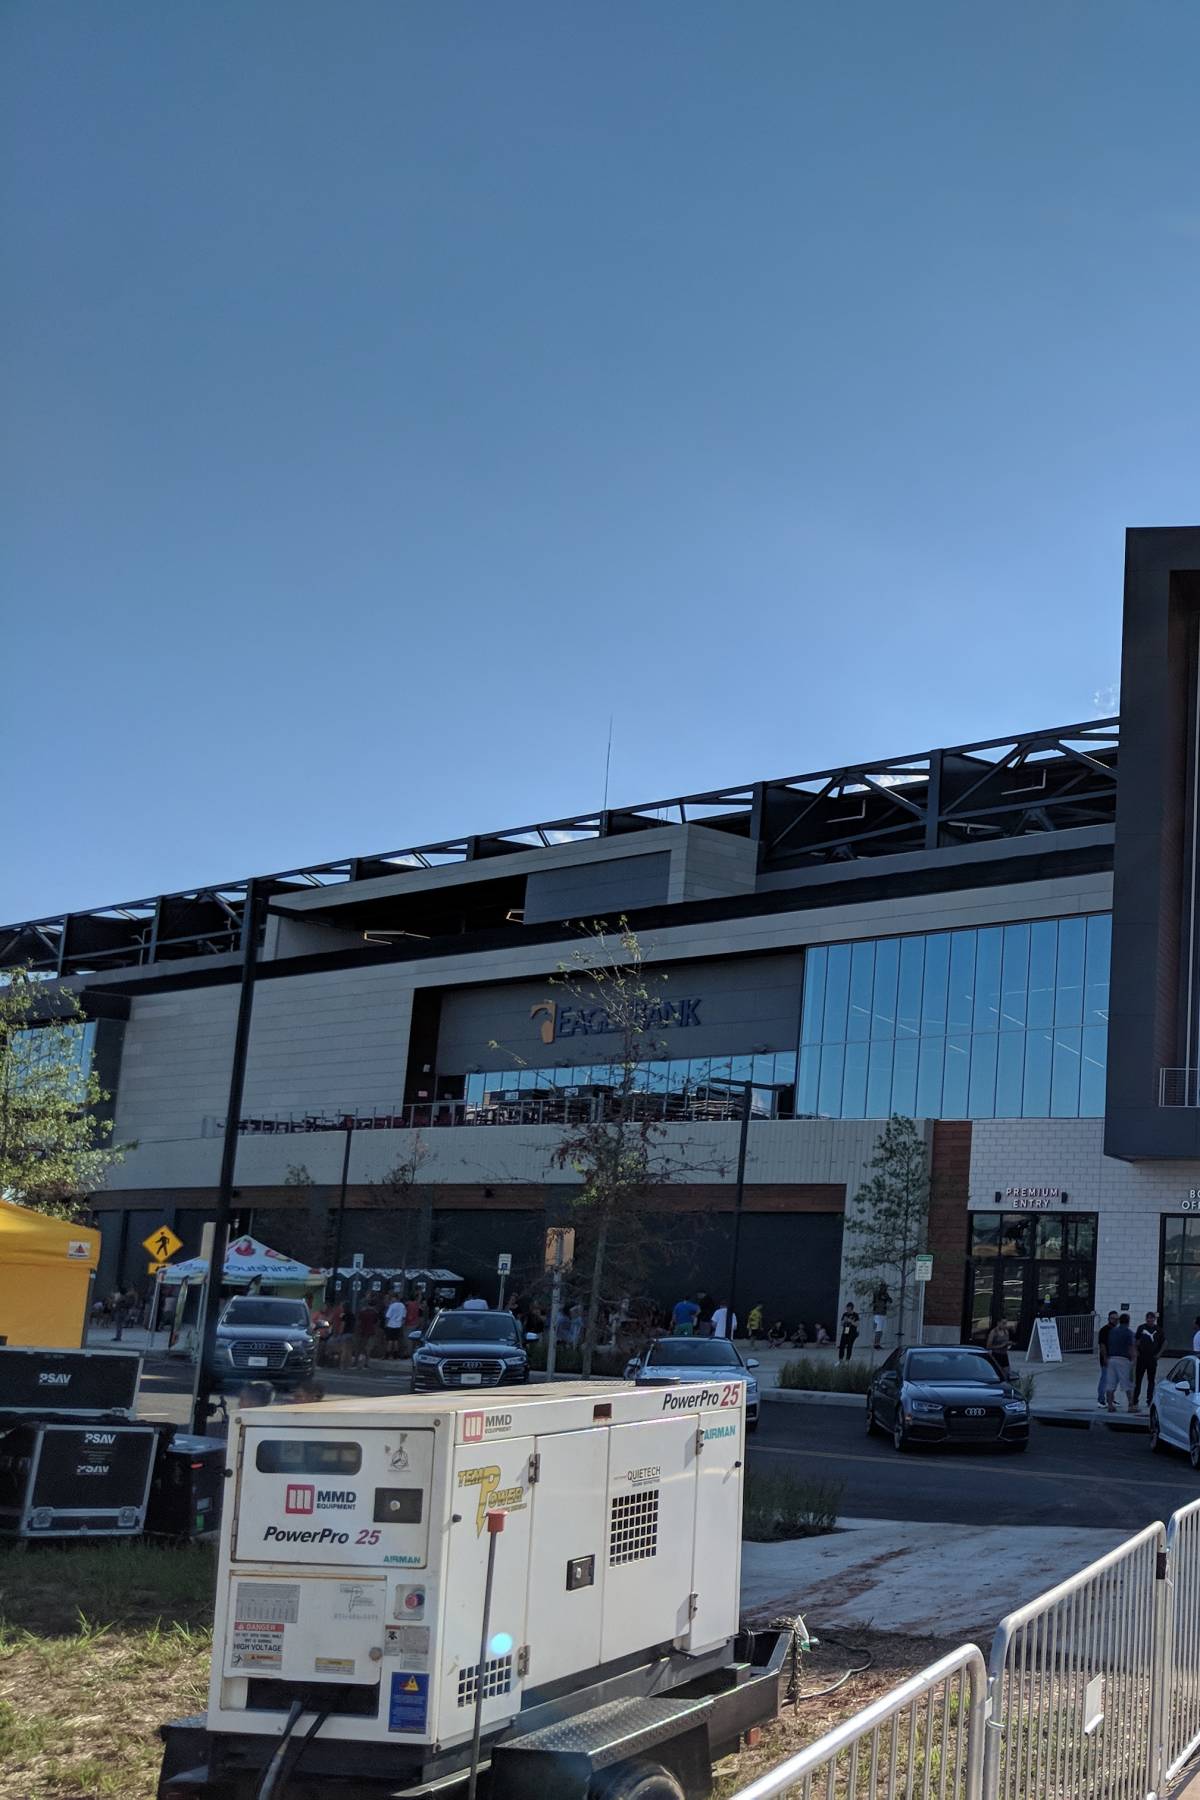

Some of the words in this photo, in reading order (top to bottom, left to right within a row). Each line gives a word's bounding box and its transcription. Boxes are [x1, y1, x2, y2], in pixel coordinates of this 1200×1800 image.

[1006, 1187, 1059, 1198] PREMIUM
[1013, 1199, 1050, 1209] ENTRY
[225, 1264, 299, 1273] outshine
[39, 1373, 72, 1384] PSAV
[662, 1390, 719, 1411] PowerPro
[720, 1383, 741, 1407] 25
[485, 1414, 512, 1428] MMD
[84, 1433, 117, 1444] PSAV
[703, 1425, 736, 1441] AIRMAN
[627, 1466, 661, 1481] QUIETECH
[317, 1491, 357, 1503] MMD
[316, 1503, 356, 1511] EQUIPMENT
[263, 1526, 349, 1545] PowerPro
[355, 1529, 382, 1546] 25
[383, 1555, 421, 1565] AIRMAN
[246, 1623, 276, 1631] DANGER
[251, 1644, 282, 1652] VOLTAGE
